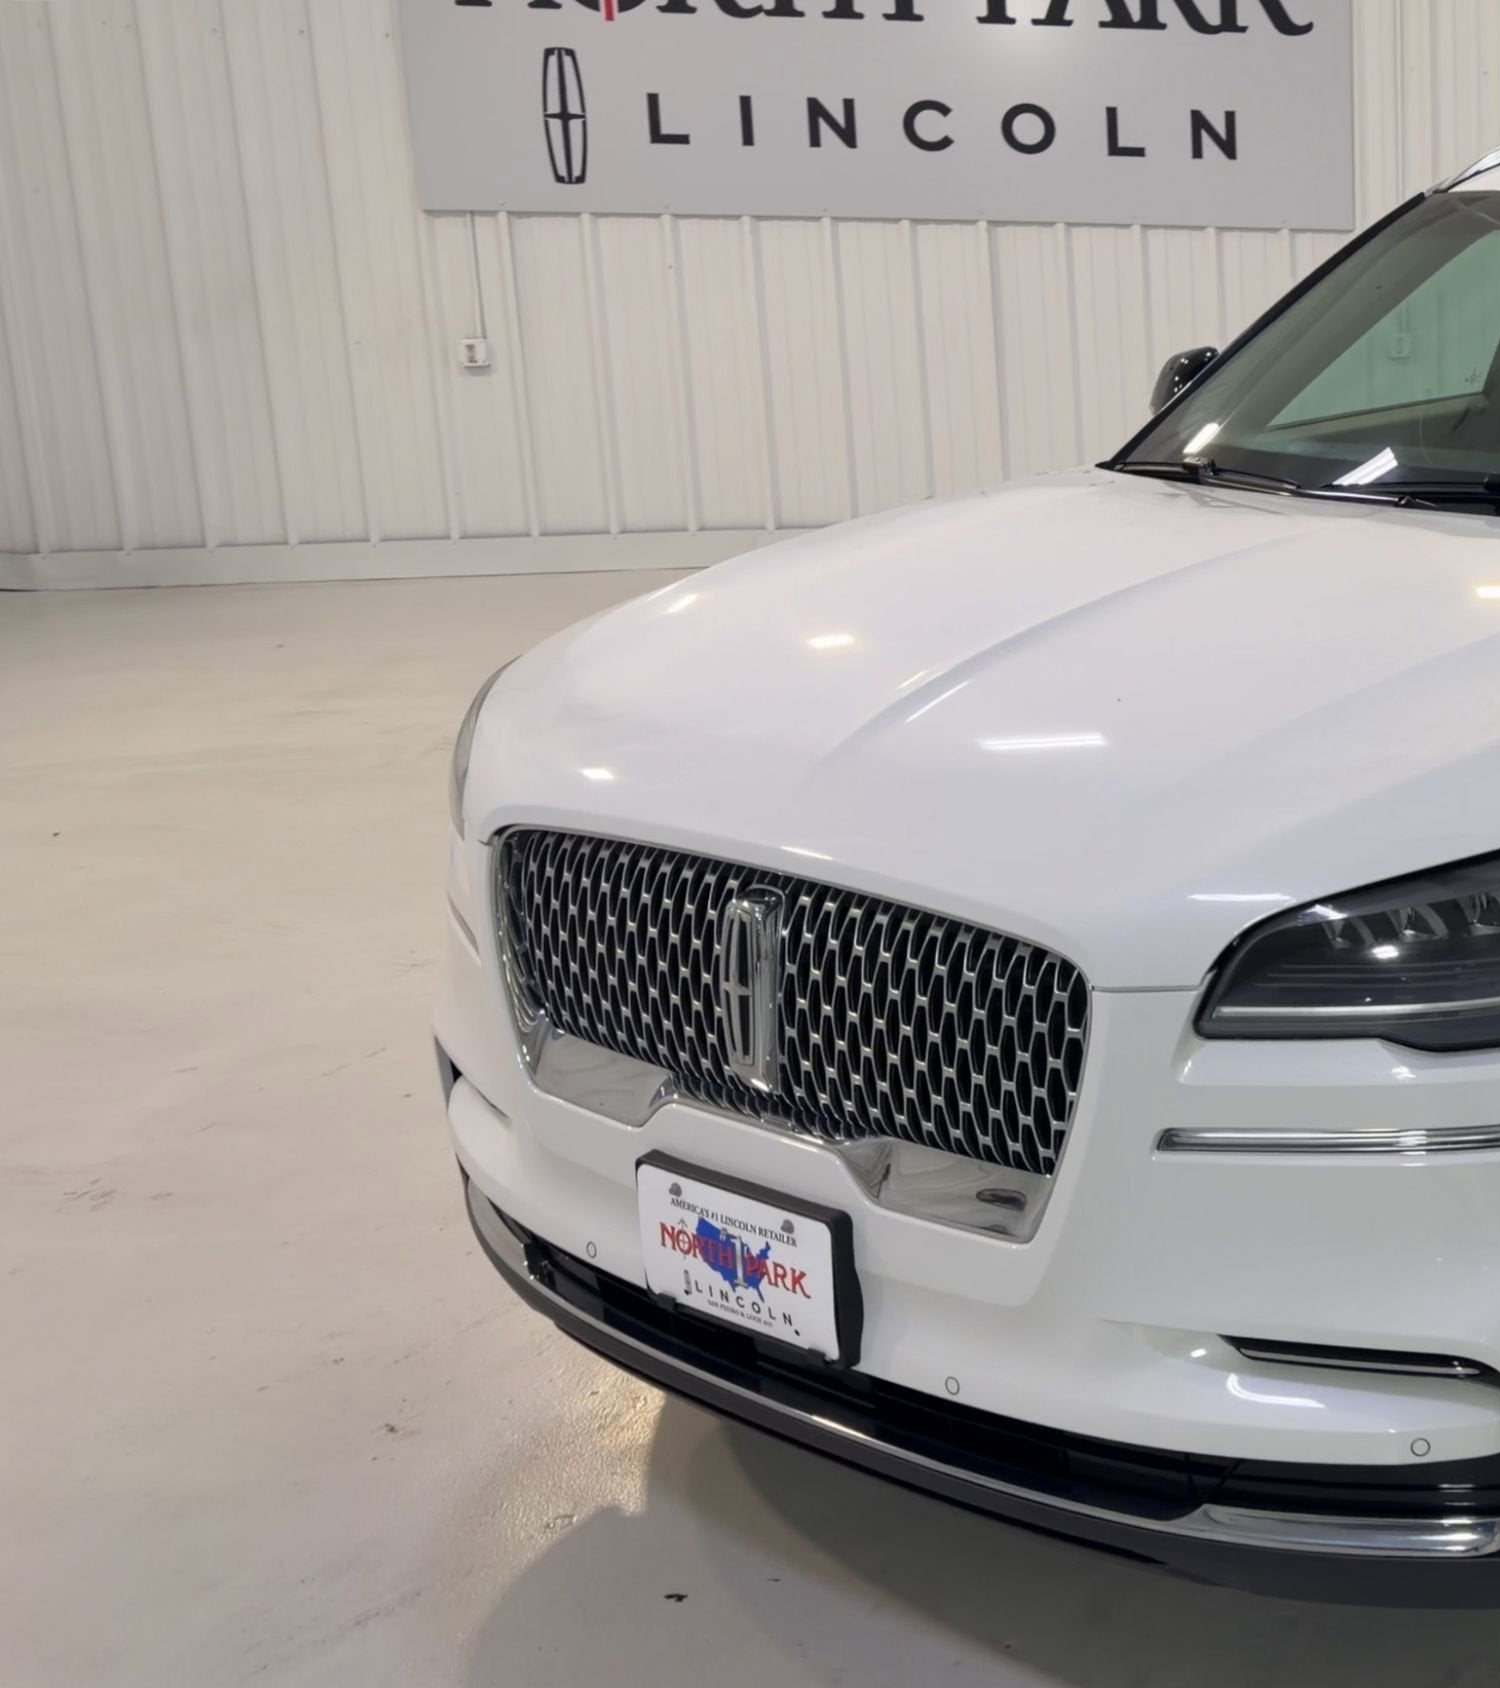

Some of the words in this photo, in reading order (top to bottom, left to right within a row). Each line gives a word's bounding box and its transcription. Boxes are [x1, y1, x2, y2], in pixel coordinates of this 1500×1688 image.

[647, 92, 1238, 161] LINCOLN
[670, 1197, 710, 1219] AMERICA'S
[720, 1214, 757, 1234] LINCOLN
[758, 1226, 797, 1248] RETAILER
[659, 1222, 734, 1270] NORTH
[745, 1250, 811, 1299] PARK
[695, 1280, 792, 1327] LINCOLN
